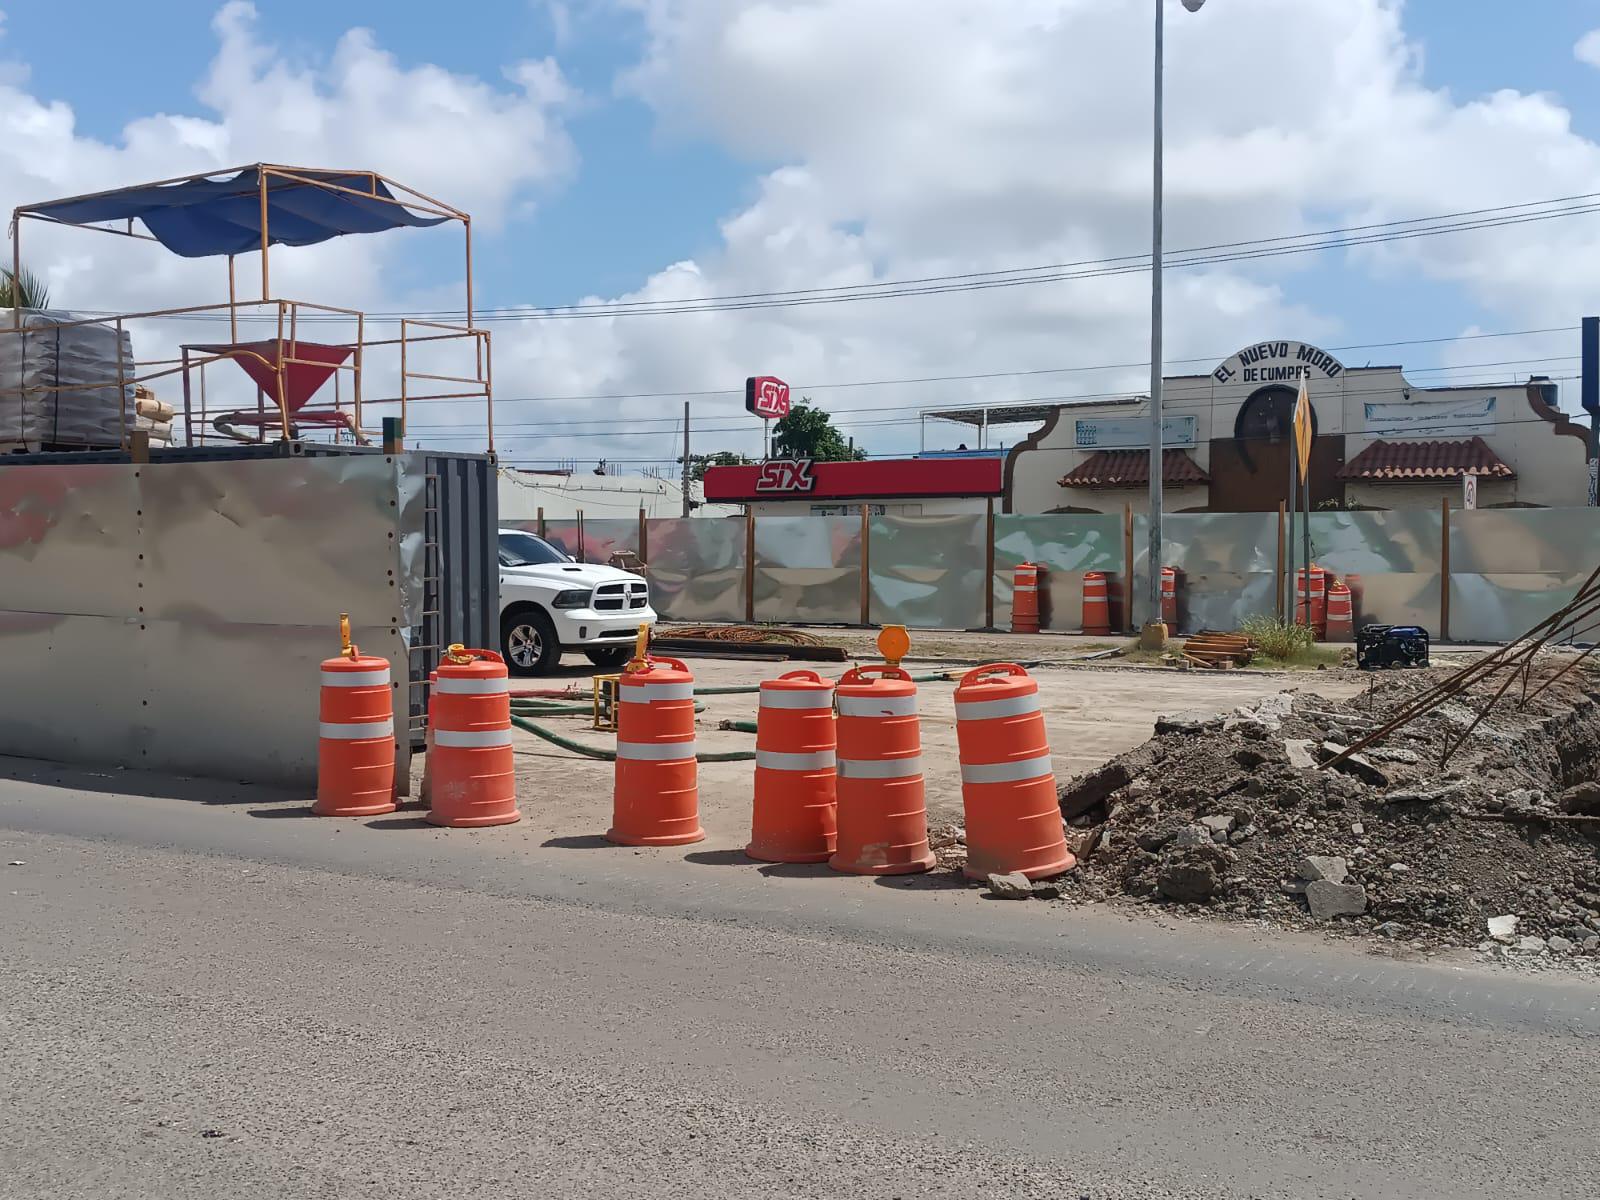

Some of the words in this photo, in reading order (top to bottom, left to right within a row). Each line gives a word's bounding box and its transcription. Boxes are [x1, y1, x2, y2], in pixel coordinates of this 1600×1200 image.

[1214, 365, 1236, 384] EL
[1238, 342, 1289, 367] NUEVO
[1296, 344, 1342, 378] MORO
[1243, 368, 1258, 382] DE
